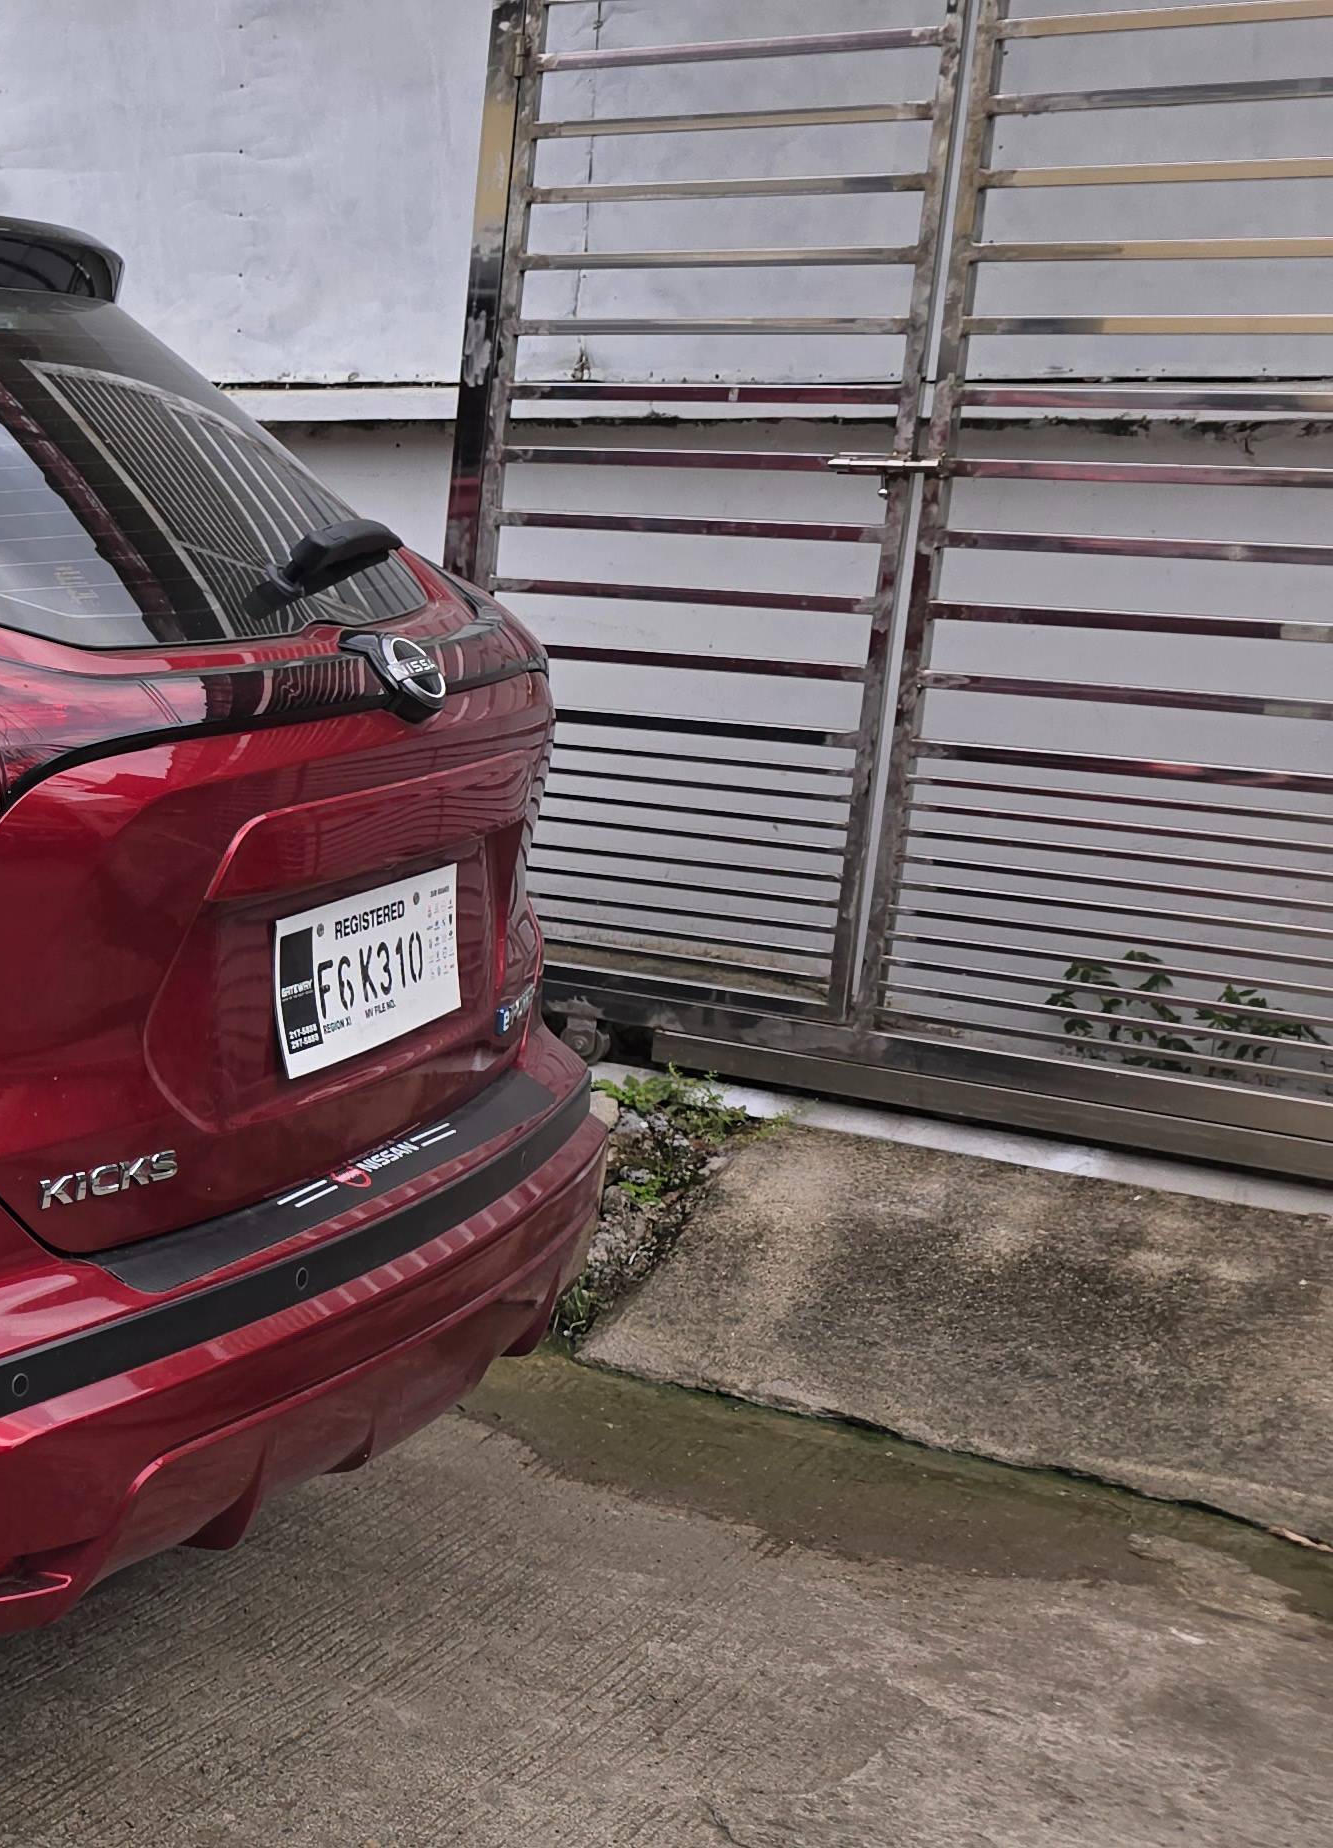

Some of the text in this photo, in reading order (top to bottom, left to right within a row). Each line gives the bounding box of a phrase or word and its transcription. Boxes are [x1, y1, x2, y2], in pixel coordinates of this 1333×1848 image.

[334, 900, 405, 940] REGISTERED
[323, 1019, 344, 1035] REGION
[356, 1141, 420, 1173] NISSAN
[38, 1149, 178, 1210] KICKS
